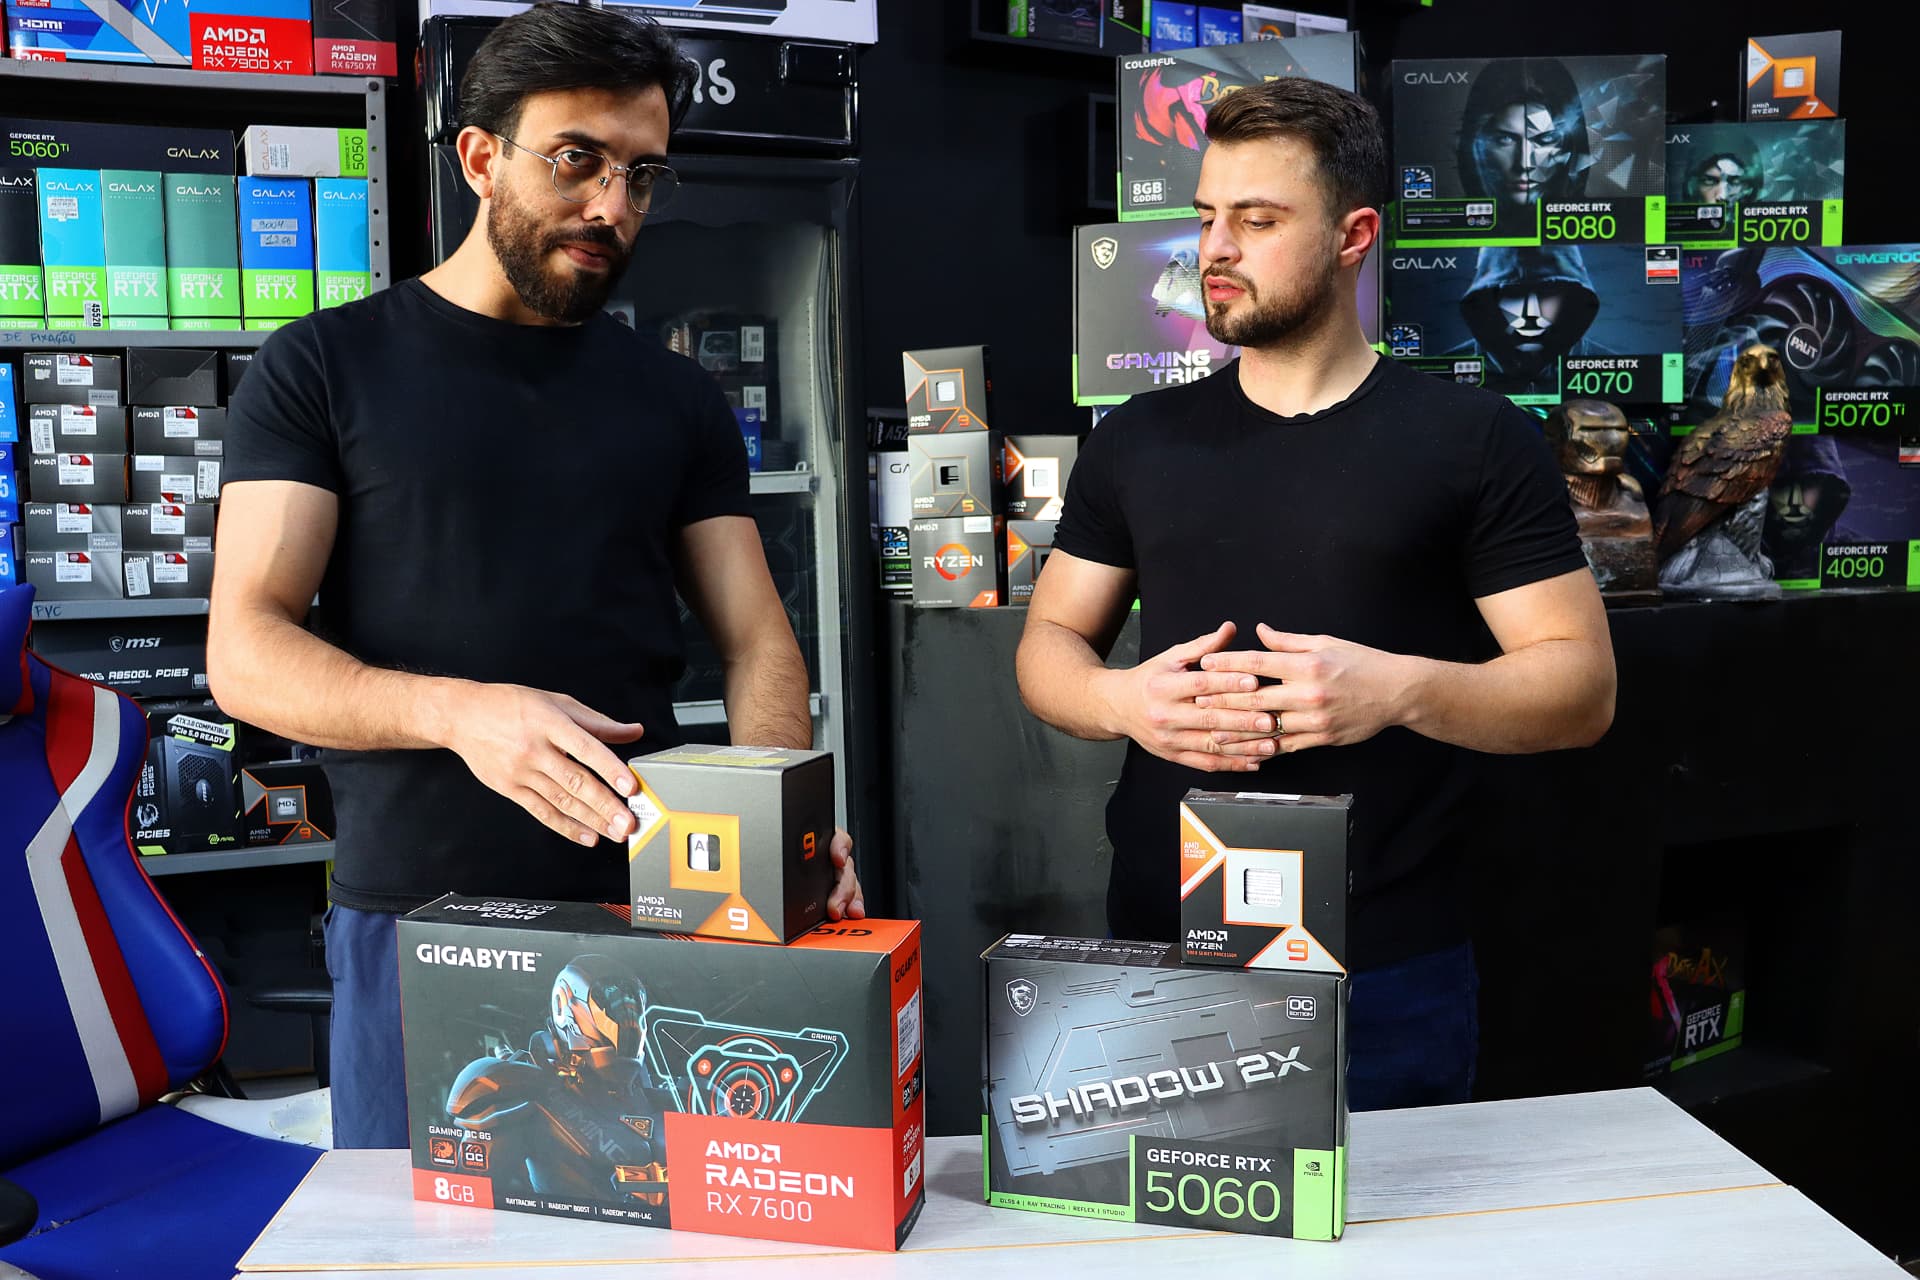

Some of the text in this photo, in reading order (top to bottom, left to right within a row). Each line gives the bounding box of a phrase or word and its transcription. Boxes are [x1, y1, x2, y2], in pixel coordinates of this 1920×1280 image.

[19, 18, 63, 30] HDMI
[203, 27, 256, 42] AMD
[1157, 23, 1182, 41] CORE
[1203, 29, 1226, 45] CORE
[203, 45, 269, 58] RADEON
[331, 52, 376, 62] RADEON
[203, 57, 293, 71] RX 7900 XT
[344, 62, 364, 70] 6750
[1125, 57, 1176, 70] COLORFUL
[1404, 72, 1469, 85] GALAX
[1806, 102, 1819, 114] 7
[10, 141, 60, 158] 5060
[167, 147, 220, 159] GALAX
[260, 129, 270, 171] GALAX
[351, 136, 364, 170] 5050
[46, 182, 94, 192] GALAX
[109, 183, 155, 193] GALAX
[176, 186, 222, 196] GALAX
[252, 189, 296, 198] GALAX
[1132, 182, 1163, 196] 8GB
[1404, 189, 1432, 198] OC
[323, 192, 366, 200] GALAX
[1132, 194, 1163, 203] GDDR6
[1546, 203, 1611, 213] GEFORCE RTX
[1744, 206, 1808, 216] GEFORCE RTX
[1545, 215, 1616, 239] 5080
[1743, 218, 1810, 242] 5070
[1392, 257, 1457, 270] GALAX
[0, 274, 38, 283] EFORCE
[52, 272, 97, 281] GEFORCE
[114, 272, 159, 281] GEFORCE
[180, 273, 223, 282] GEFORCE
[255, 274, 297, 283] GEFORCE
[326, 276, 365, 284] GEFORCE
[0, 283, 40, 300] RTX
[52, 280, 98, 297] RTX
[114, 280, 158, 297] RTX
[180, 281, 224, 298] RTX
[256, 283, 297, 299] RTX
[326, 284, 366, 301] RTX
[91, 303, 101, 327] 45520
[5, 332, 22, 342] DE
[1392, 347, 1420, 356] OC
[1106, 350, 1210, 369] GAMING
[1567, 359, 1639, 370] GEFORCE RTX
[1147, 367, 1210, 385] TRIO
[1567, 372, 1633, 394] 4070
[1825, 391, 1889, 401] GEFORCE RTX
[957, 415, 970, 426] 9
[1824, 403, 1891, 427] 5070
[962, 499, 974, 512] 5
[914, 524, 934, 532] AMD
[1827, 545, 1888, 556] GEFORCE RTX
[924, 555, 983, 569] RYZEN
[1826, 557, 1884, 578] 4090
[984, 594, 994, 606] 7
[34, 605, 63, 617] PVC
[125, 637, 161, 649] msi
[175, 717, 230, 736] ATX COMPATIBLE
[200, 733, 225, 744] READY
[803, 831, 815, 861] 9
[638, 896, 660, 905] AMD
[637, 905, 682, 919] RYZEN
[728, 907, 749, 931] 9
[1186, 929, 1222, 940] AMD
[1186, 941, 1222, 951] RYZEN
[1286, 939, 1308, 962] 9
[1289, 998, 1314, 1011] OC
[1687, 1004, 1721, 1025] GEFORCE
[811, 1033, 837, 1042] GAMING
[1685, 1015, 1720, 1048] RTX
[1010, 1046, 1312, 1130] SHADOW 2X
[428, 1126, 492, 1141] GAMING OC 8G
[465, 1152, 484, 1162] OC
[705, 1141, 771, 1163] AMD
[1146, 1149, 1230, 1169] GEFORCE
[705, 1164, 854, 1198] RADEON
[505, 1197, 537, 1208] RAYTRACING
[1145, 1170, 1281, 1223] 5060
[573, 1204, 591, 1214] BOOST
[707, 1192, 812, 1223] RX 7600
[1040, 1202, 1065, 1210] TRACING
[627, 1211, 652, 1221] ANTI-LAG
